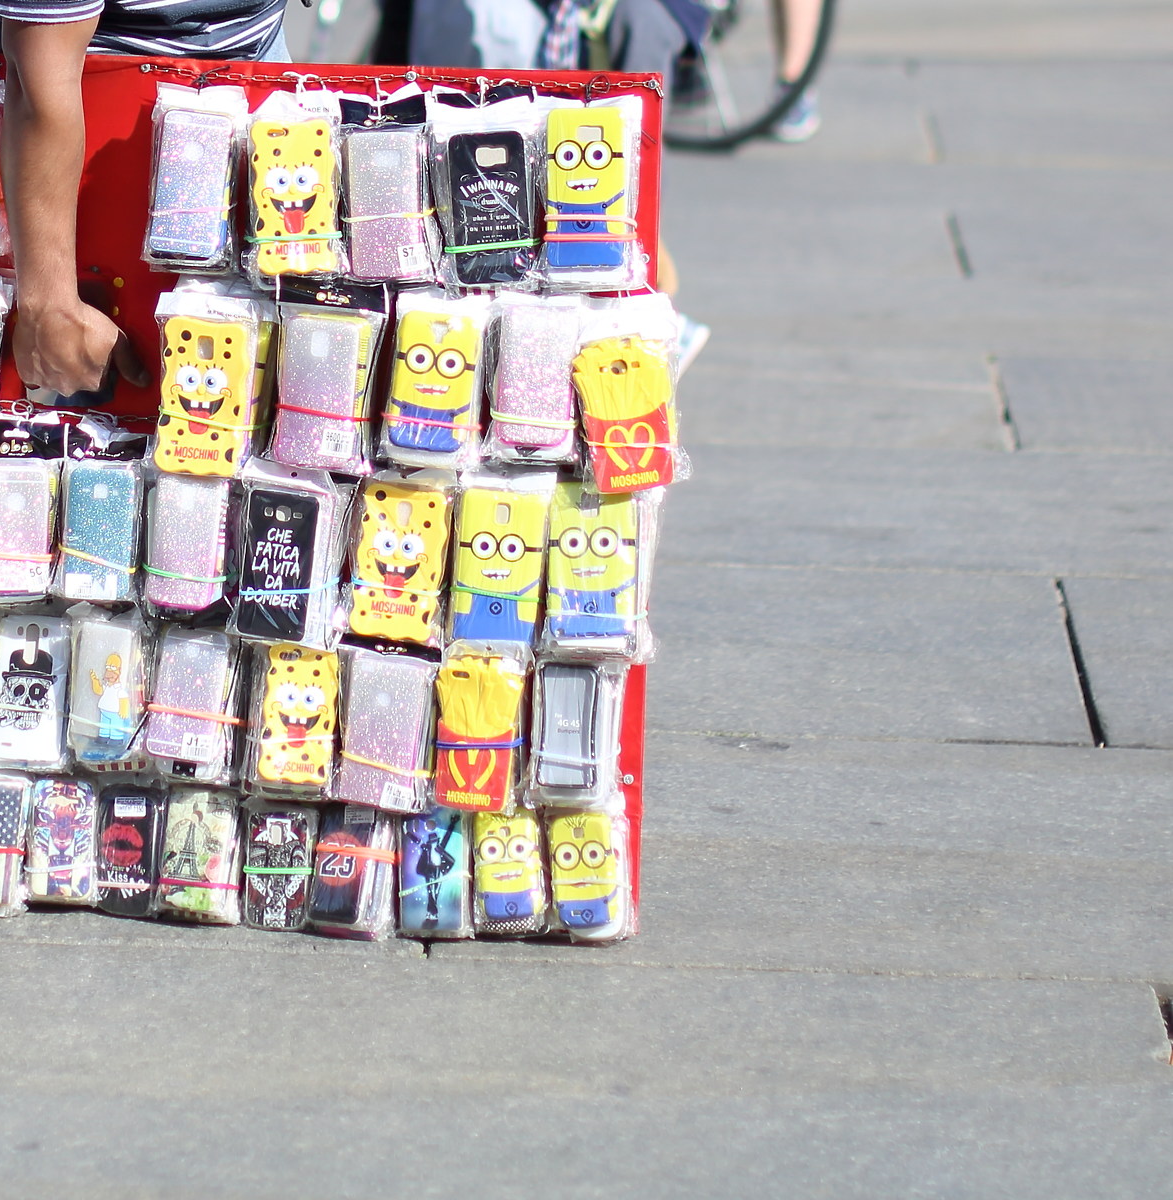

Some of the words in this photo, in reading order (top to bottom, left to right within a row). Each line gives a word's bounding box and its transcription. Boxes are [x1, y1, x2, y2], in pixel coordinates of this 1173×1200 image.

[459, 185, 470, 198] I
[402, 246, 414, 258] S7
[174, 445, 220, 462] MOSCHINO
[610, 471, 659, 488] MOSCHINO
[267, 527, 294, 544] CHE
[255, 541, 300, 560] FATICA
[29, 566, 43, 578] 5C
[251, 556, 269, 575] LA
[272, 560, 301, 580] VITA
[264, 574, 284, 591] DA
[370, 599, 416, 617] MOSCHINO
[186, 737, 199, 747] J1
[446, 790, 491, 807] MOSCHINO
[319, 842, 356, 879] 23
[107, 870, 129, 883] Kiss
